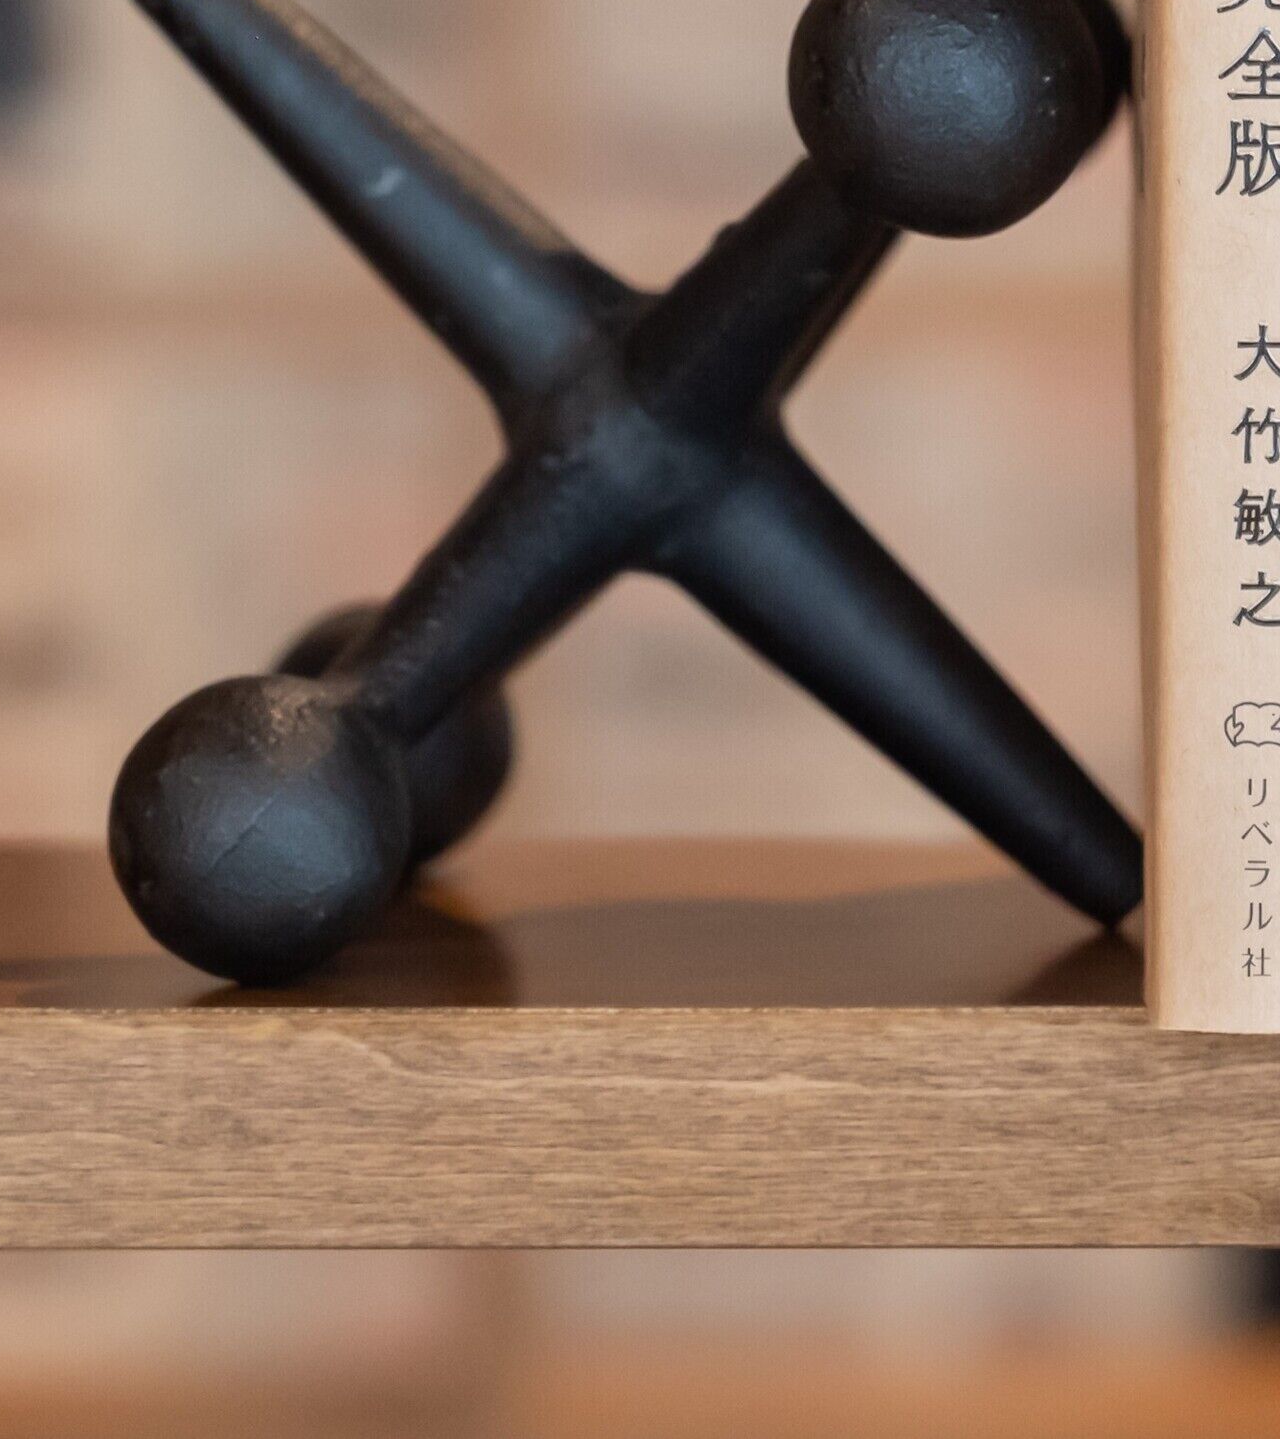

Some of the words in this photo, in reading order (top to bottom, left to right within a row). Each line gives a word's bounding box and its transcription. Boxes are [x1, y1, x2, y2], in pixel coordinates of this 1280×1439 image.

[1239, 777, 1274, 978] リベラル社
